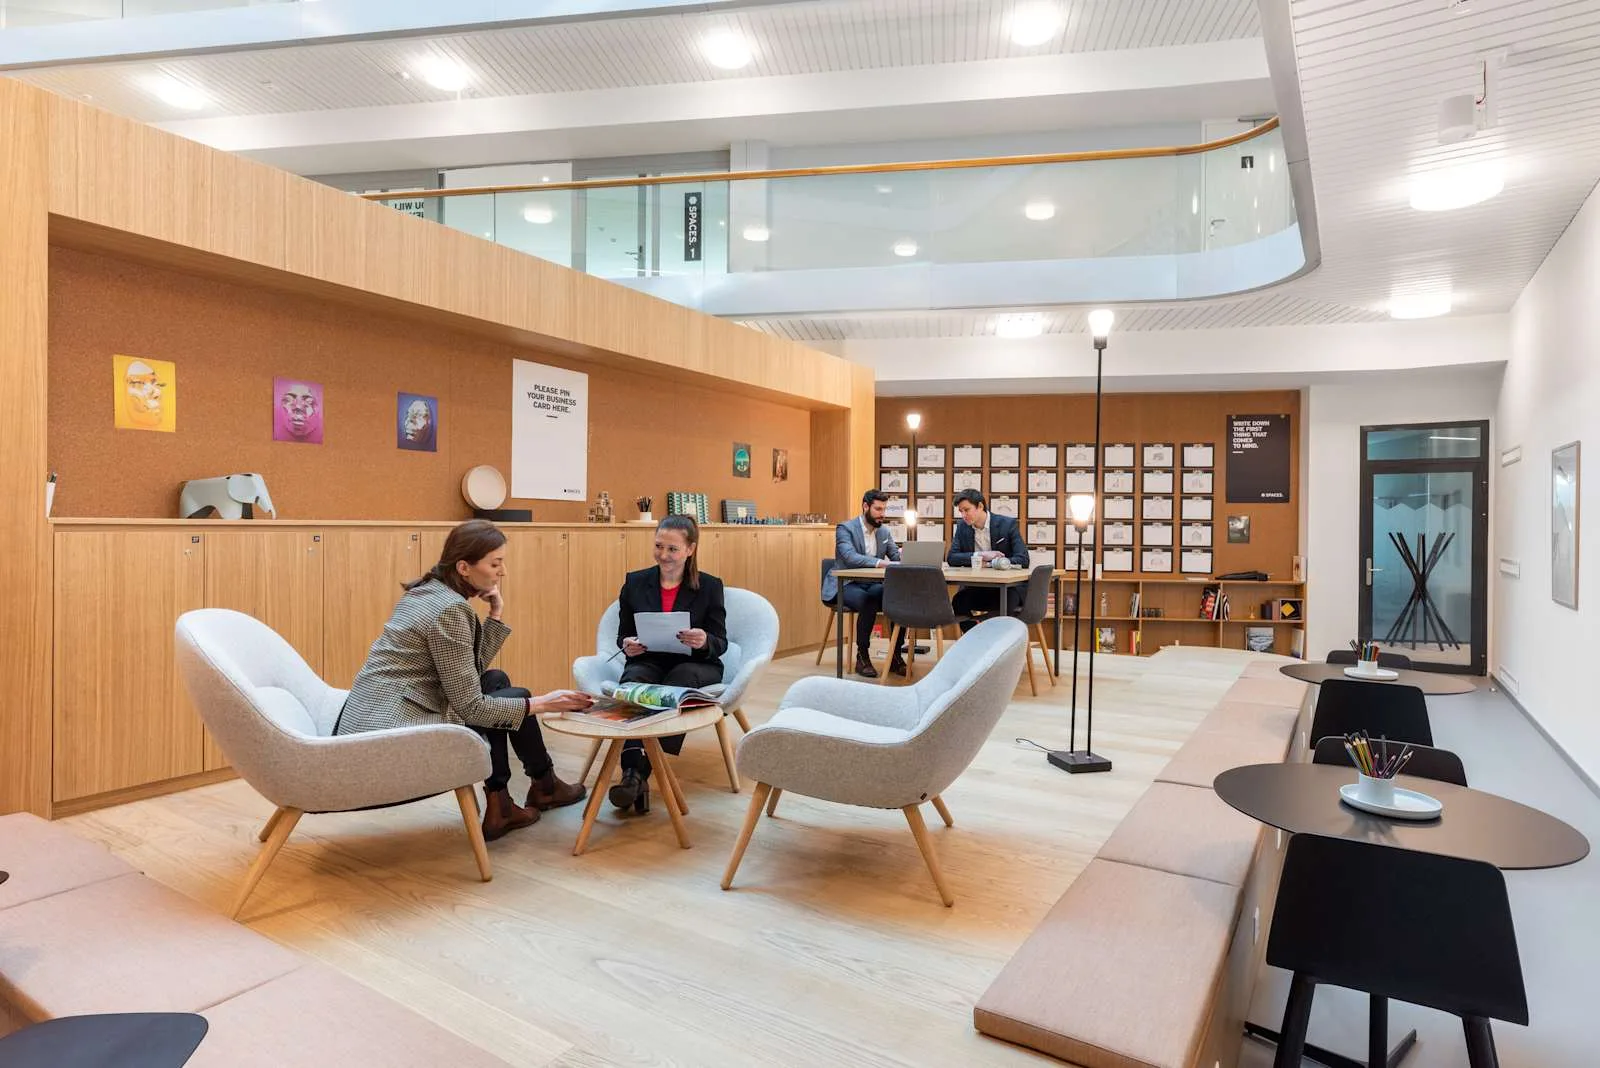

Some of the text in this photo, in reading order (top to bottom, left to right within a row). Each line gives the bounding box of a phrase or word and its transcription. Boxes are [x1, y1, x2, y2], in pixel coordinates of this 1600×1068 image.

[688, 206, 698, 259] SPACES. 1
[533, 384, 571, 397] PLEASE PIN
[527, 391, 577, 406] YOUR BUSINESS
[533, 401, 571, 413] CARD HERE.
